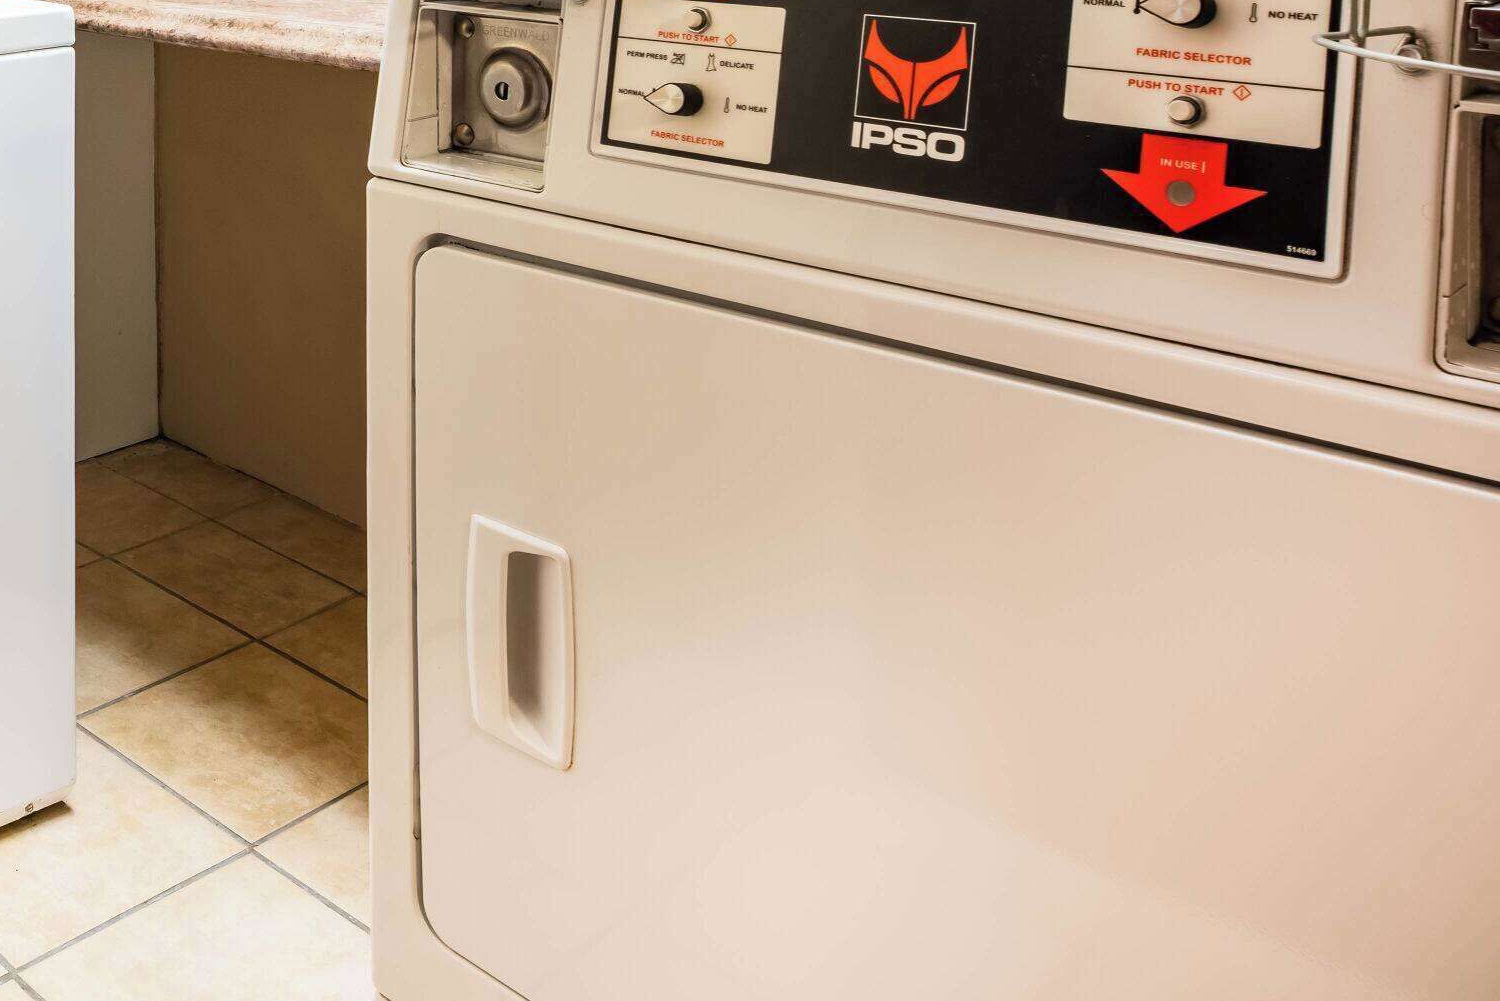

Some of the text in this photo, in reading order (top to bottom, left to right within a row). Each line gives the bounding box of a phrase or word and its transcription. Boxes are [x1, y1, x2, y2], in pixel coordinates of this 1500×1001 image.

[1268, 11, 1319, 21] NO HEAT
[483, 24, 550, 40] GREENWALD
[658, 31, 720, 44] PUSH TO START
[626, 51, 668, 61] PERM PRESS
[1136, 48, 1252, 66] FABRIC SELECTOR
[719, 60, 755, 70] DELICATE
[618, 88, 646, 97] NORMAL
[1128, 79, 1225, 96] PUSH TO START
[736, 104, 768, 114] NO HEAT
[651, 130, 725, 148] FABRIC SELECTOR
[851, 121, 965, 162] IPSO
[1160, 158, 1198, 171] IN USE
